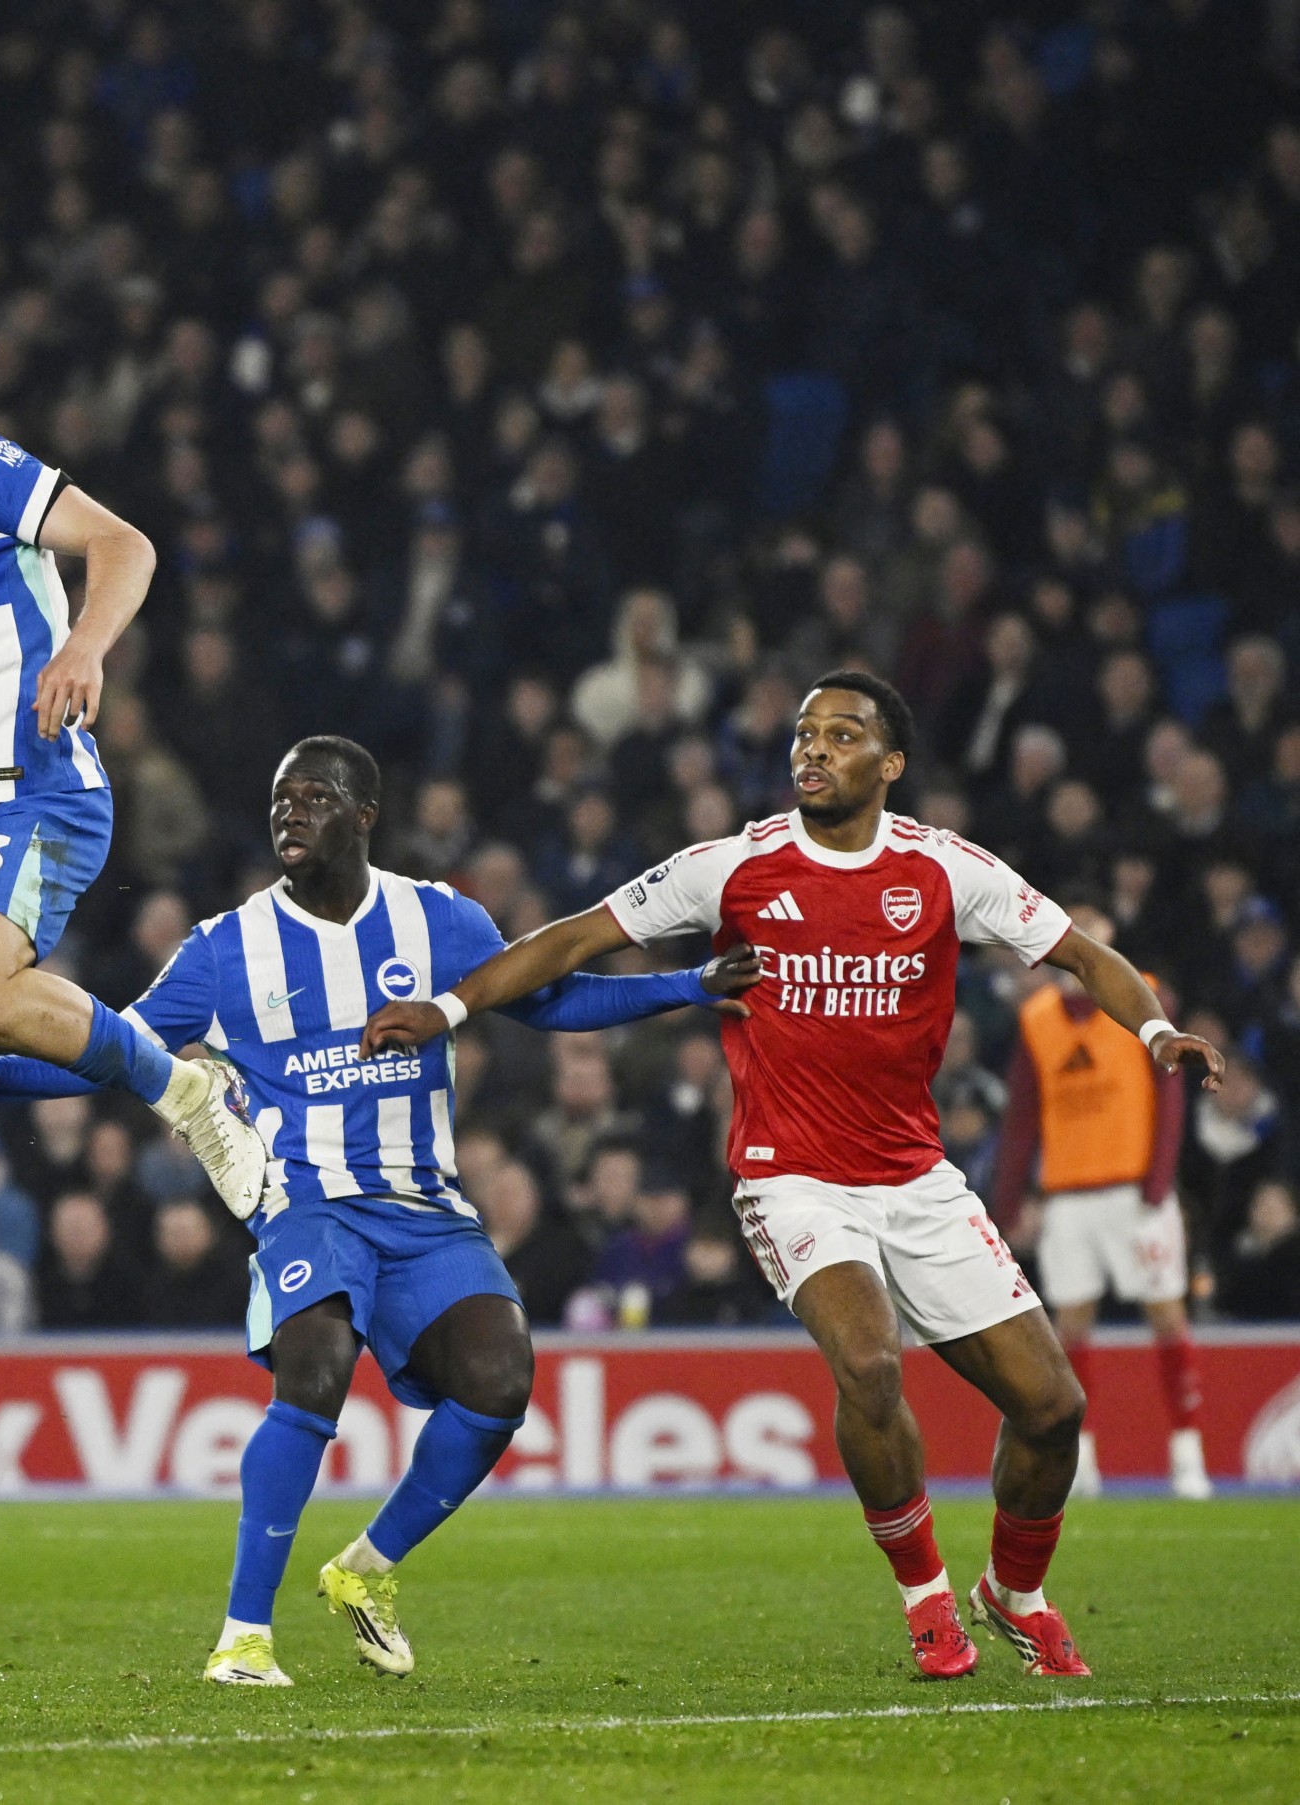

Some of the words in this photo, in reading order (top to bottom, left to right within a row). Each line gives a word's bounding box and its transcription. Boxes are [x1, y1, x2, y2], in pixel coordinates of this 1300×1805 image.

[1018, 889, 1044, 924] RWAN
[753, 945, 926, 984] Emirates
[779, 984, 817, 1014] FLY
[824, 987, 900, 1017] BETTER
[306, 1059, 421, 1095] EXPRESS
